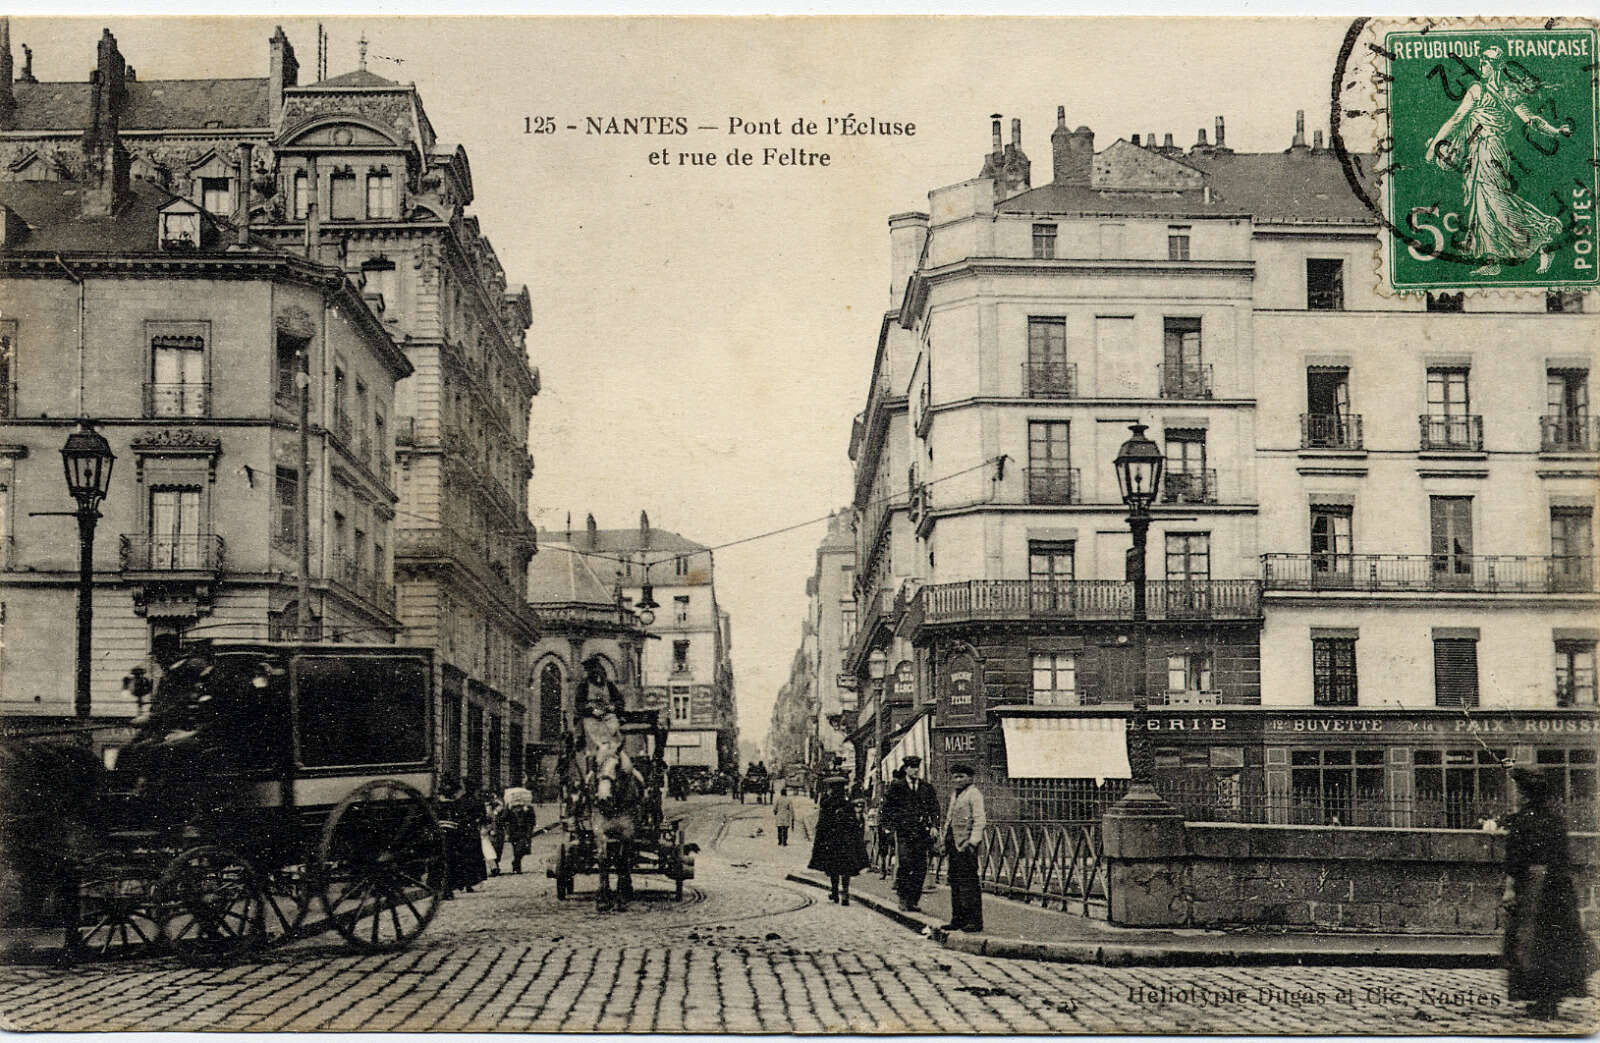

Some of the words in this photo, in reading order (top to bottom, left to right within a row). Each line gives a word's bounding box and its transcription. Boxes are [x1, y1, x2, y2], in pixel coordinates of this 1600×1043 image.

[1506, 37, 1589, 59] FRANÇAISE
[1573, 187, 1593, 271] POSTES
[1293, 719, 1383, 732] BUVETTE
[1454, 718, 1505, 732] PAIX
